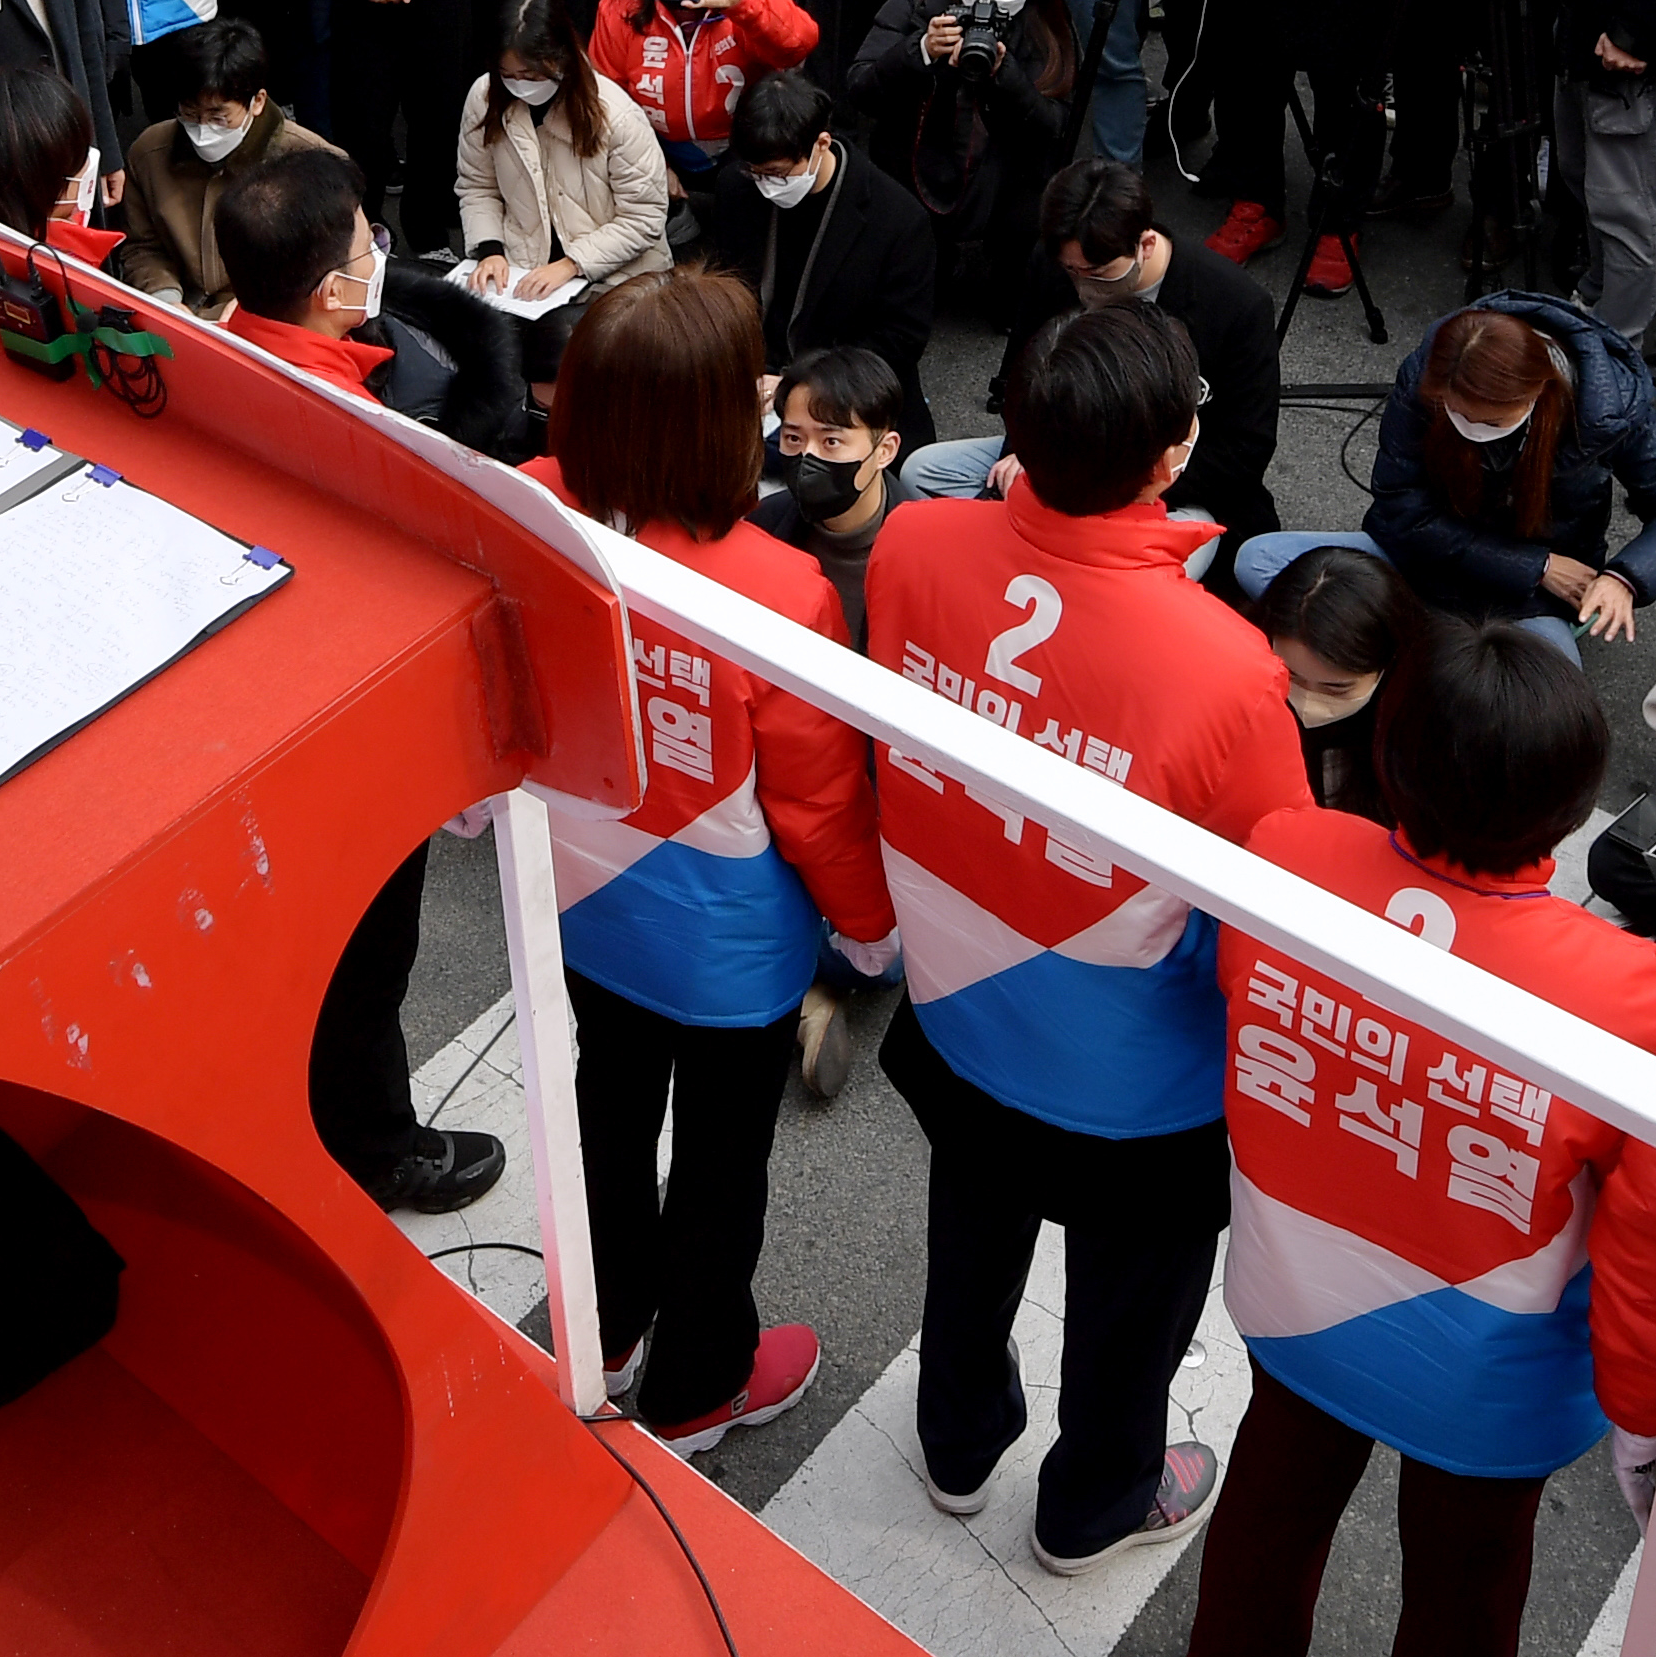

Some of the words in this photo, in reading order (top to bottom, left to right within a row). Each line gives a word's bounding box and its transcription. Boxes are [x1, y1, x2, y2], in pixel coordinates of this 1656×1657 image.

[983, 573, 1064, 699] 2
[1235, 1022, 1540, 1235] 윤석열
[1246, 959, 1411, 1086] 국민의
[1426, 1050, 1553, 1146] 선택
